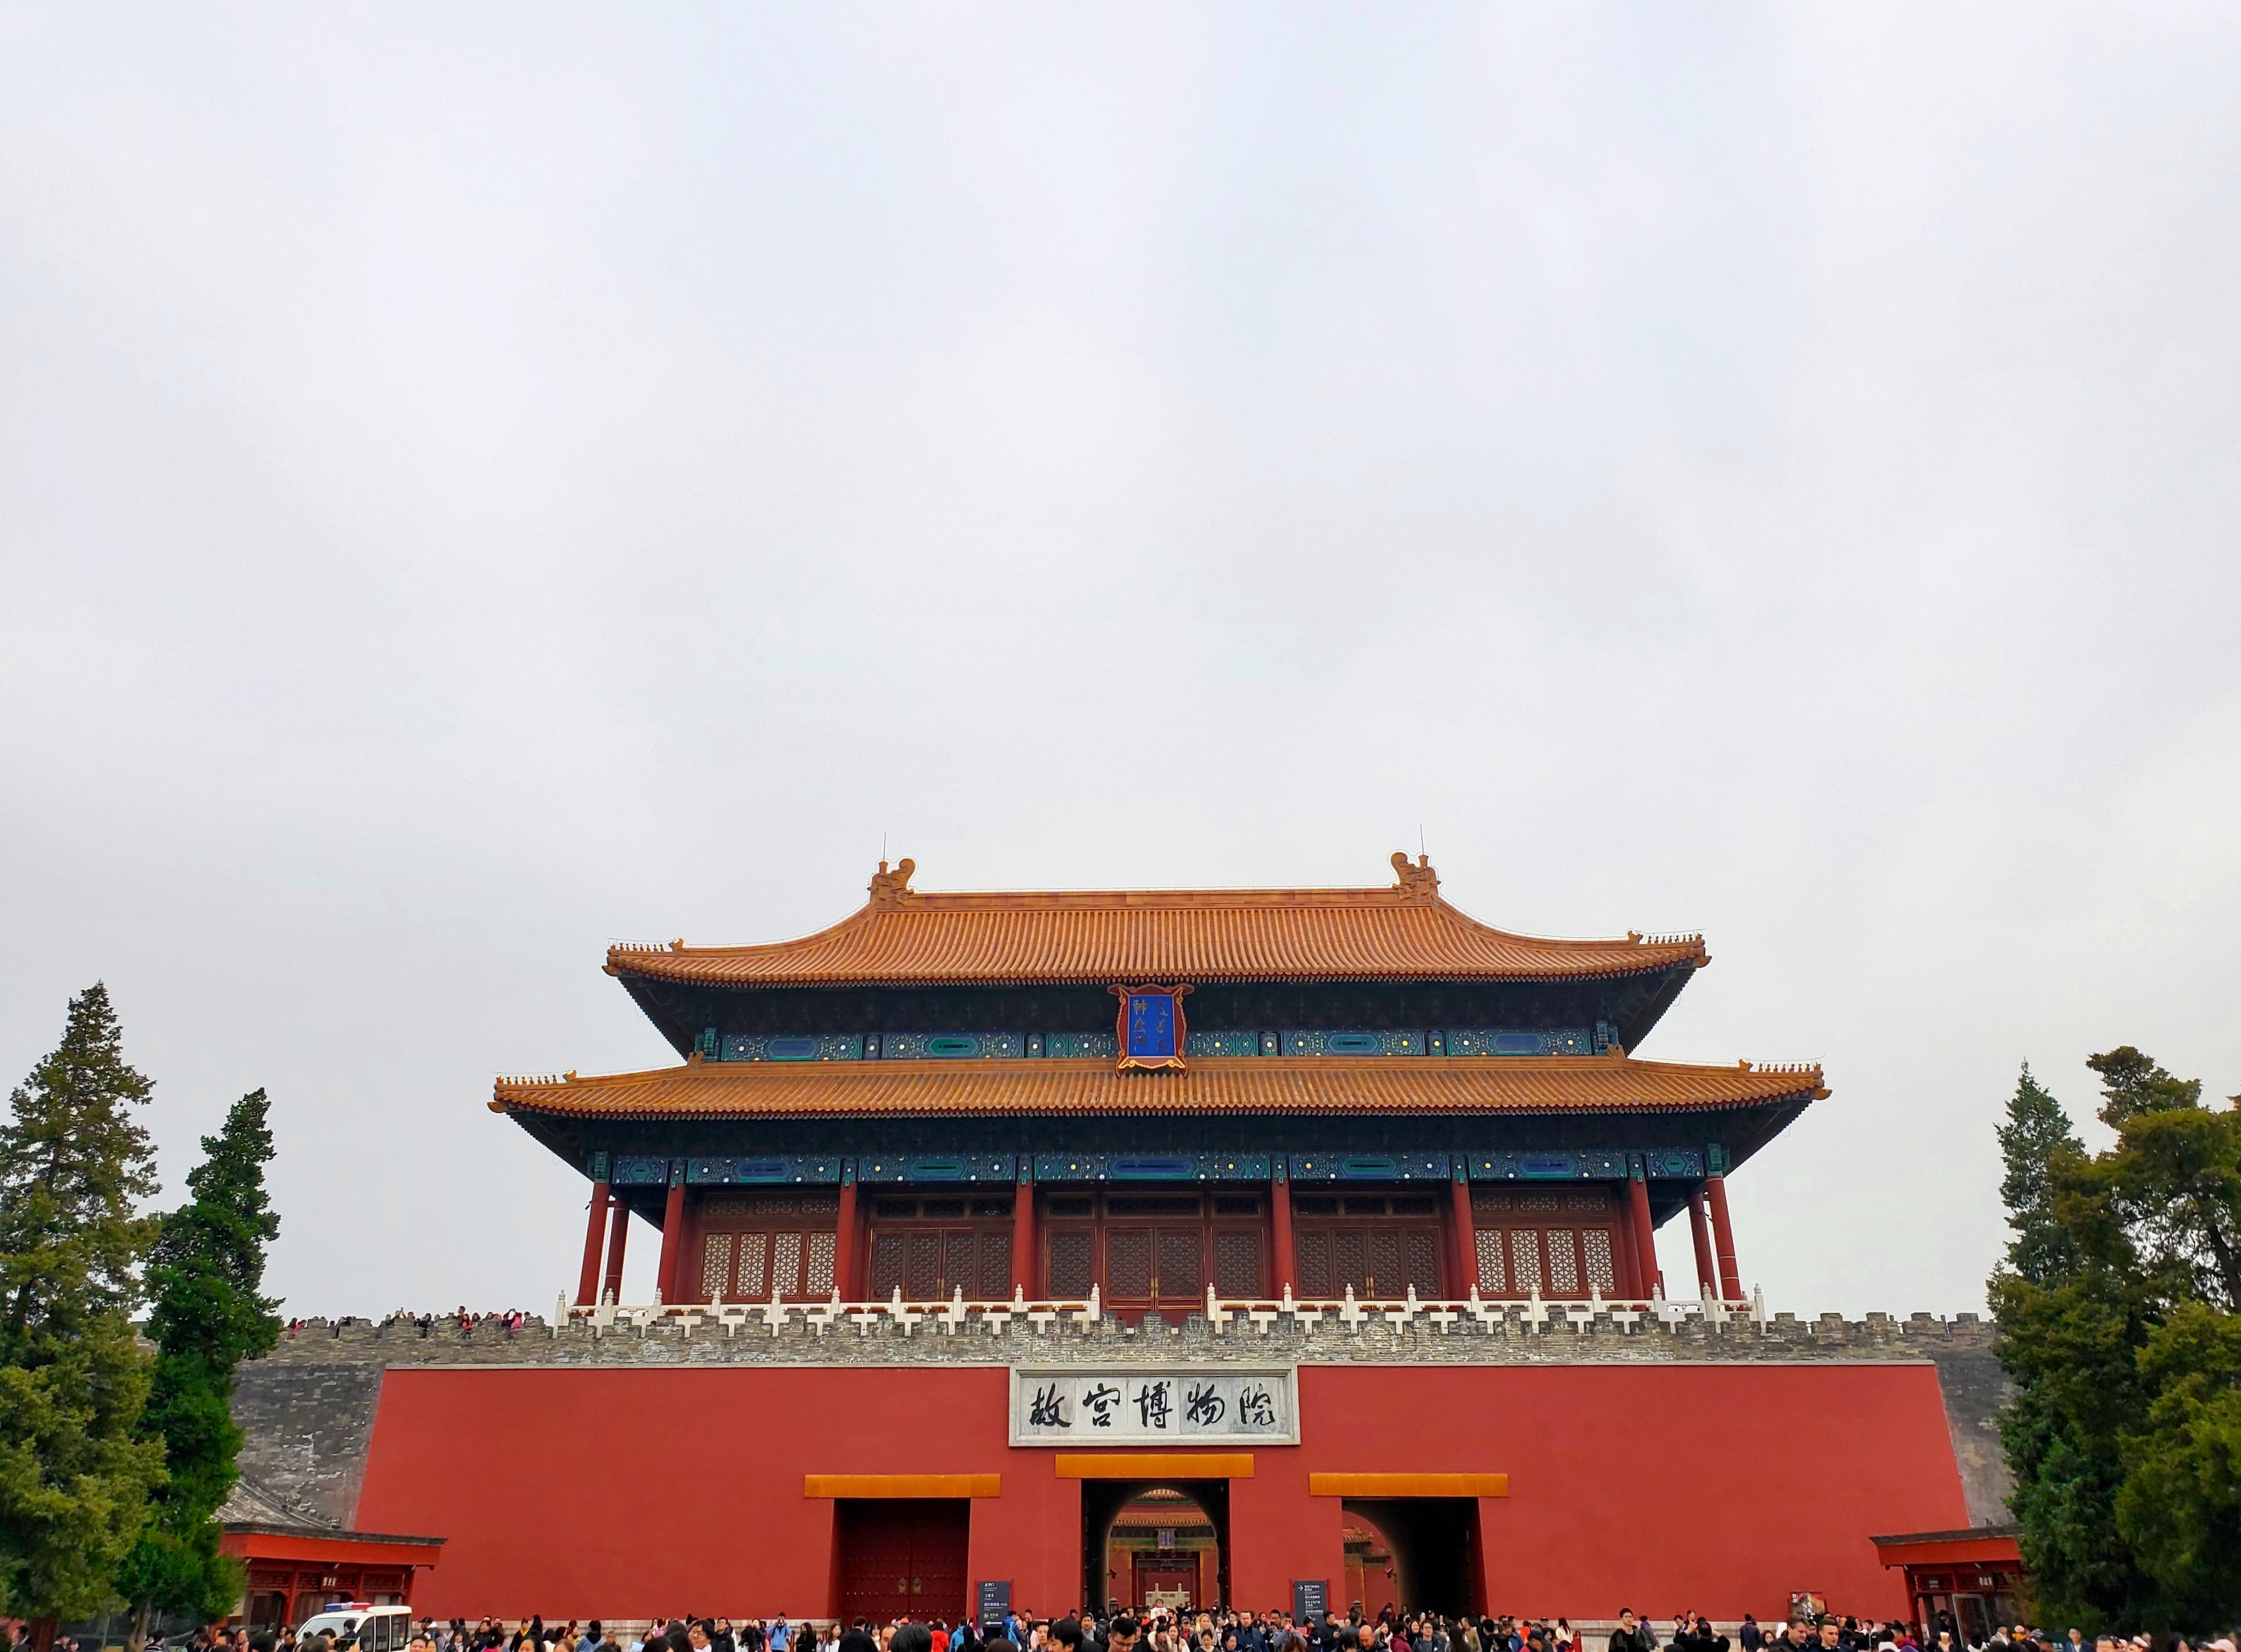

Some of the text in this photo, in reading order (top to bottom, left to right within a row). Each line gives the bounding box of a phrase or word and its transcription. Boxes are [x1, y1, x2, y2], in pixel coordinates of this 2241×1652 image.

[1029, 1380, 1276, 1429] 故宫博物院
